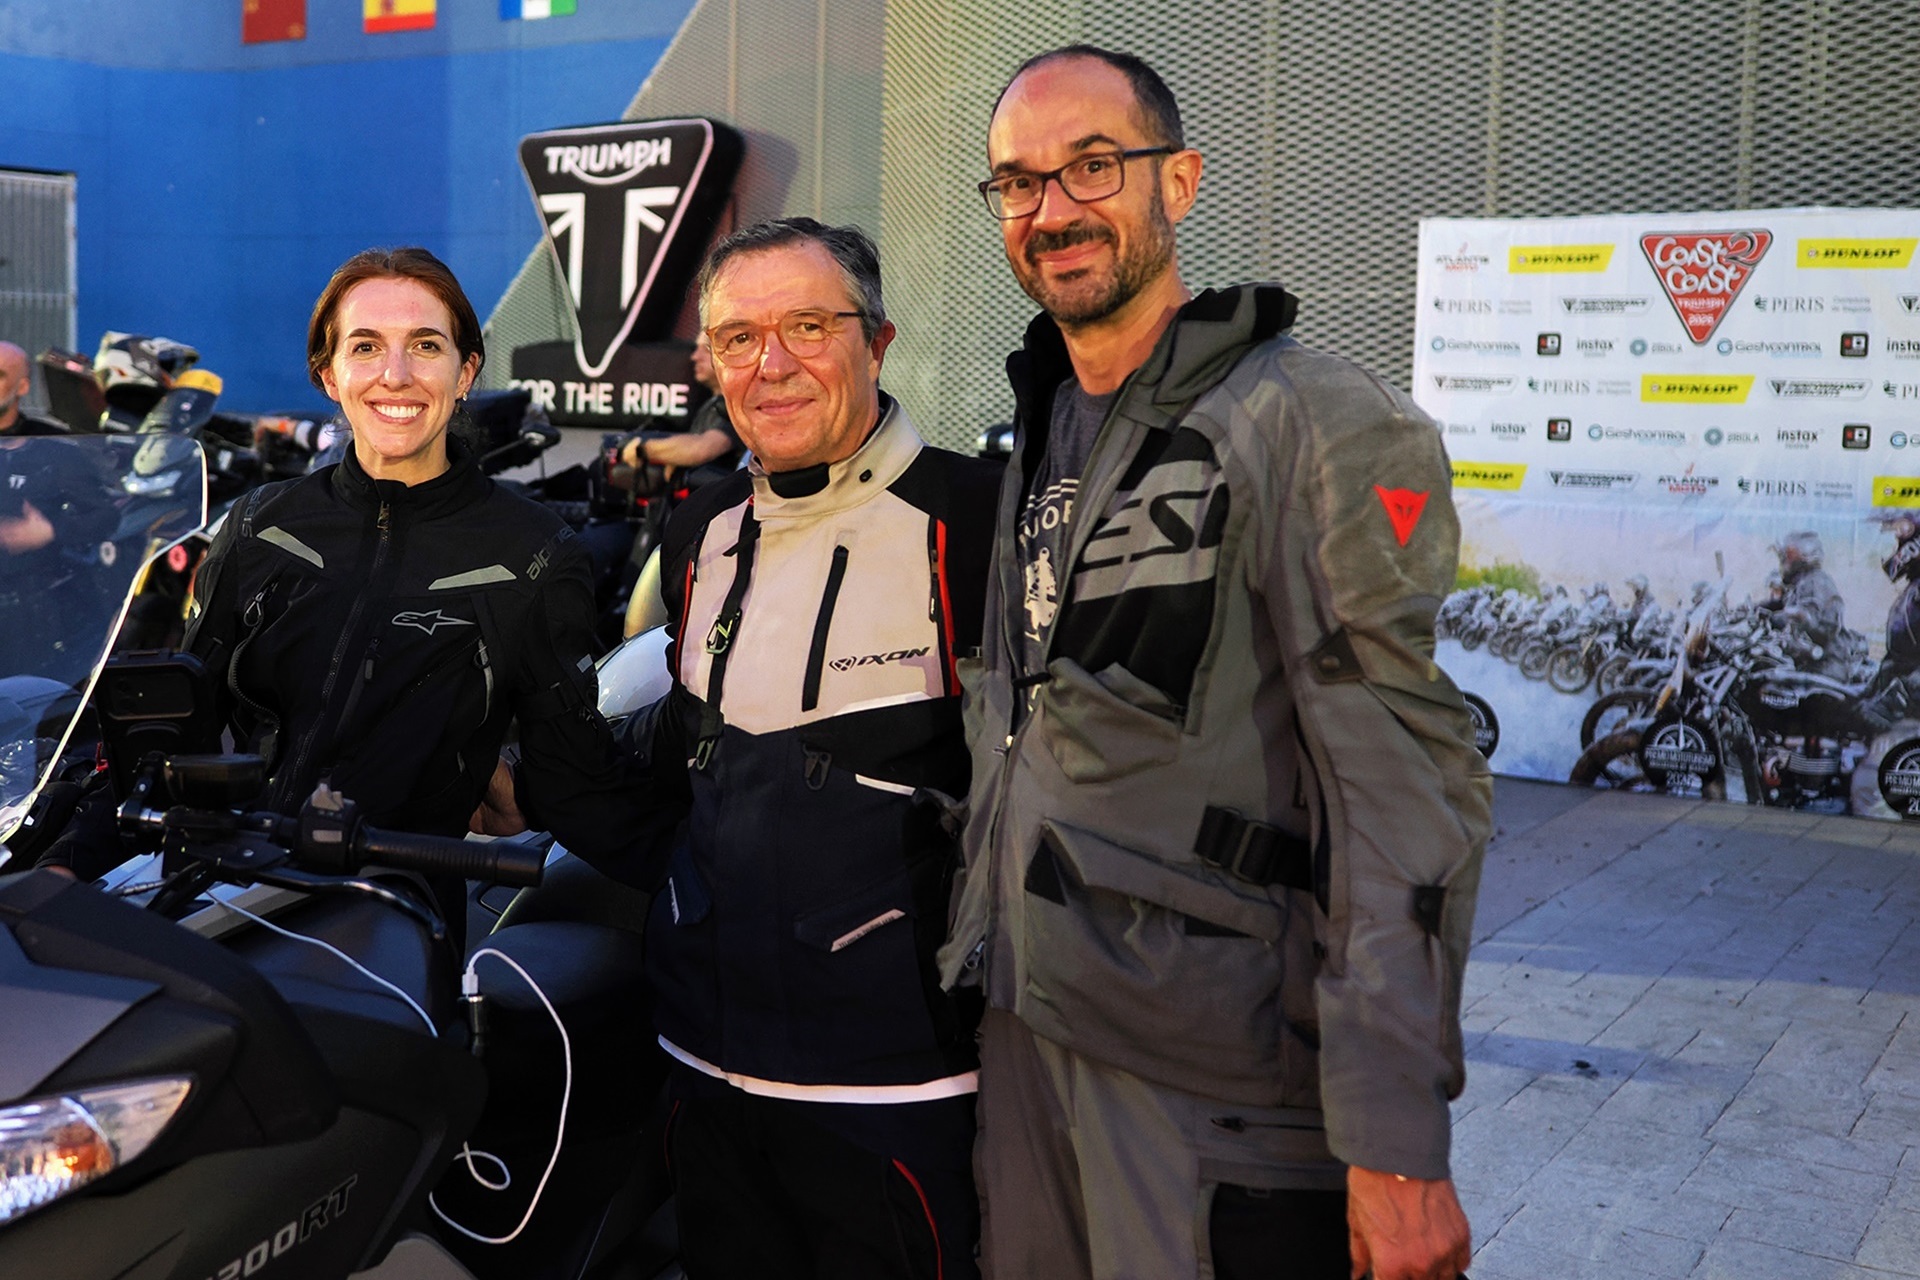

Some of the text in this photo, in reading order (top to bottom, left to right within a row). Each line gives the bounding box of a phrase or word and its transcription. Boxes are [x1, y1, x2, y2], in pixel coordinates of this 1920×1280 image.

[544, 138, 672, 184] TRIUMPH
[1531, 254, 1600, 264] DUNLOP
[1824, 248, 1900, 259] DUNLOP
[1449, 300, 1492, 315] PERIS
[1678, 297, 1725, 312] TRIUMPH
[1772, 296, 1824, 313] PERIS
[1577, 338, 1614, 350] instax
[1544, 379, 1590, 394] PERIS
[1665, 384, 1738, 394] DUNLOP
[563, 382, 614, 414] THE
[622, 382, 689, 416] RIDE
[1491, 421, 1527, 435] instax
[1777, 427, 1818, 443] instax
[1755, 479, 1806, 495] PERIS
[857, 646, 931, 666] IXON
